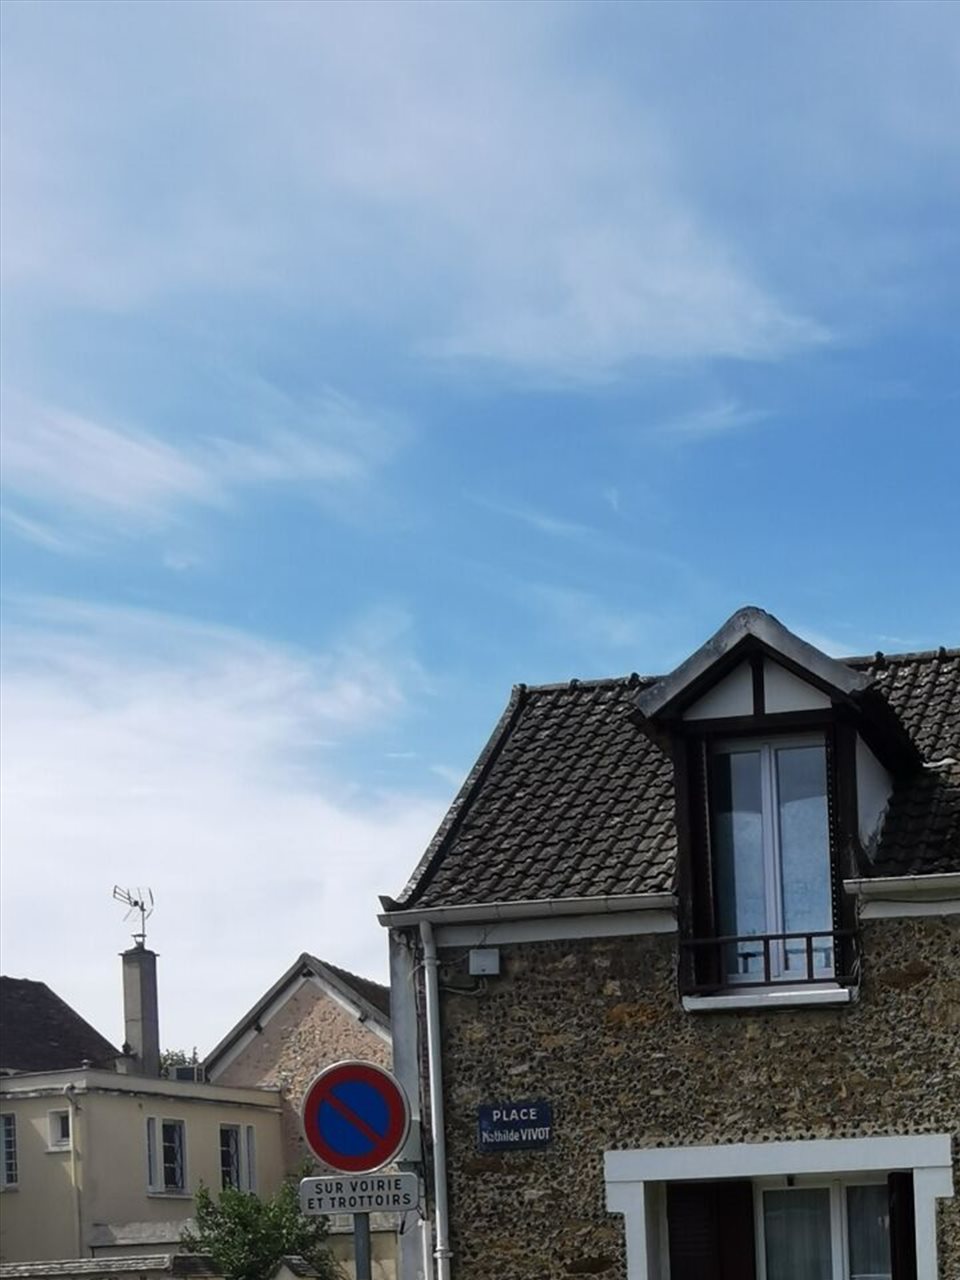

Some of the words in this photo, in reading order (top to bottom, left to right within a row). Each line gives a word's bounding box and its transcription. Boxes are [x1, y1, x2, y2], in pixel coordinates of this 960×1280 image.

[492, 1108, 538, 1121] PLACE
[520, 1127, 550, 1141] VIVOT
[315, 1182, 344, 1195] SUR
[350, 1179, 402, 1192] VOIRIE
[308, 1197, 323, 1209] ET
[329, 1193, 411, 1208] TROTTOIRS
